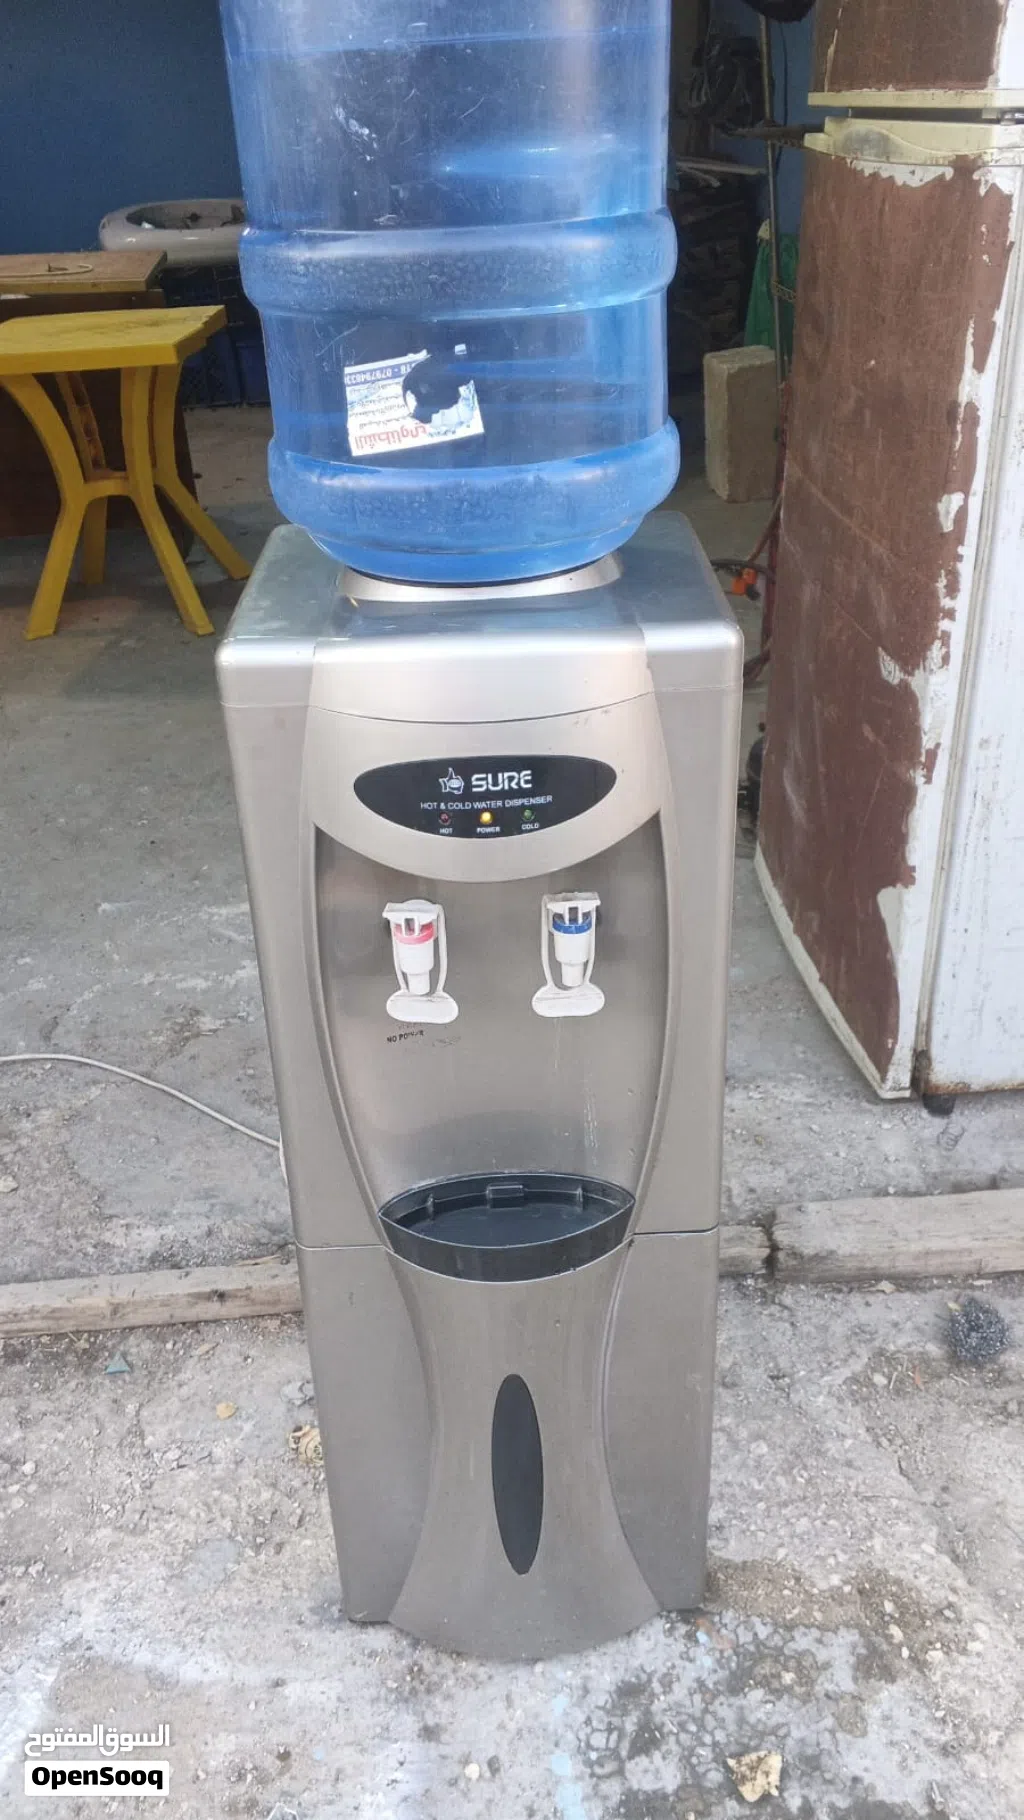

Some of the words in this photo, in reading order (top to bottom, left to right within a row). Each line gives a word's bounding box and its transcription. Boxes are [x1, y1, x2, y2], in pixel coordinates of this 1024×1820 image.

[471, 770, 533, 792] SURE
[420, 802, 438, 810] HOT
[440, 802, 446, 810] &
[447, 801, 472, 810] COLD
[473, 800, 503, 809] WATER
[505, 795, 553, 807] DISPENSER
